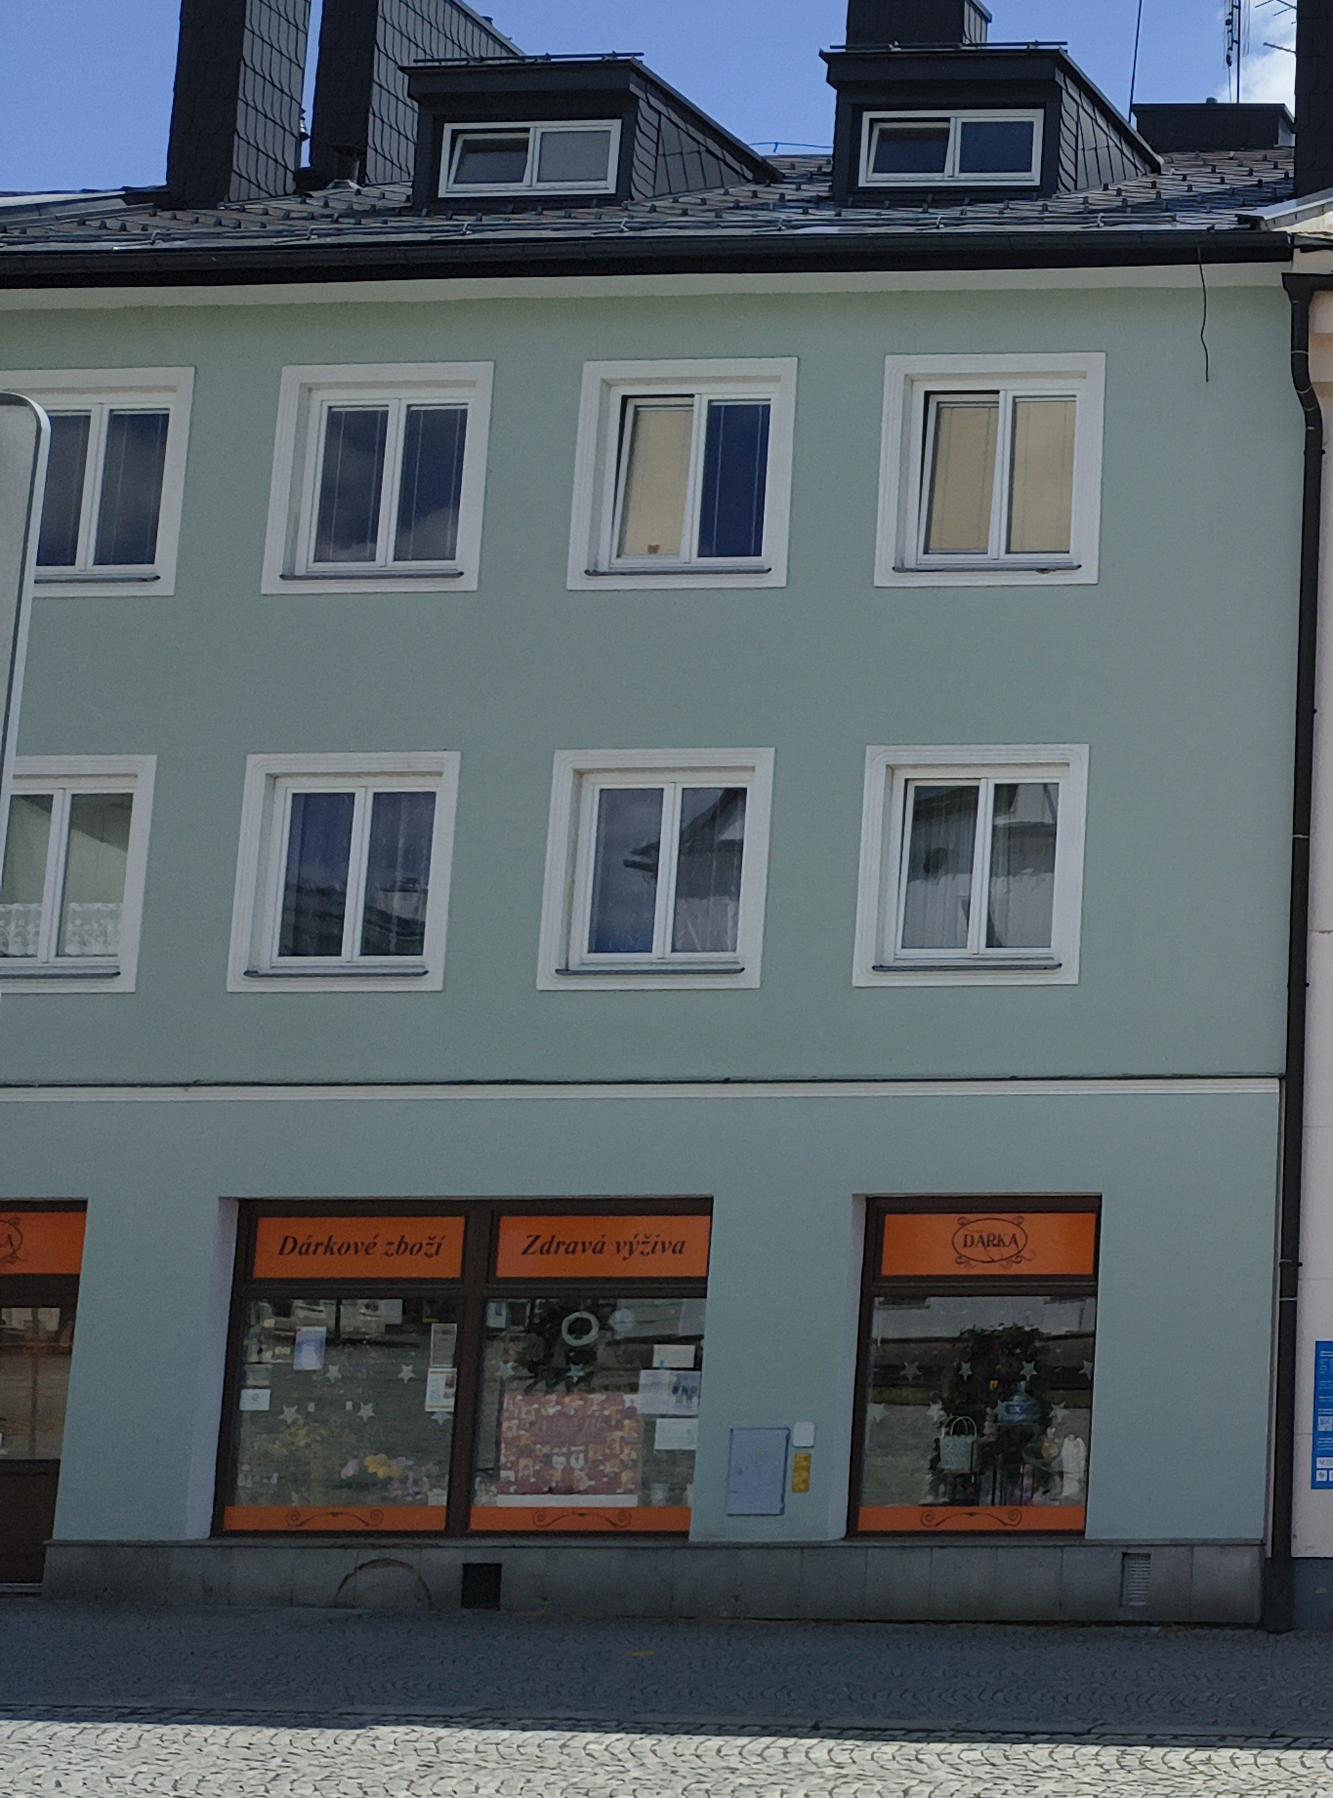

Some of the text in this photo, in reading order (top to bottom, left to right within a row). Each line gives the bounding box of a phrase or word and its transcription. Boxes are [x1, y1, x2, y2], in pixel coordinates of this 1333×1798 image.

[278, 1234, 445, 1259] Dárkové zboží
[520, 1232, 687, 1261] Zdravá výživa
